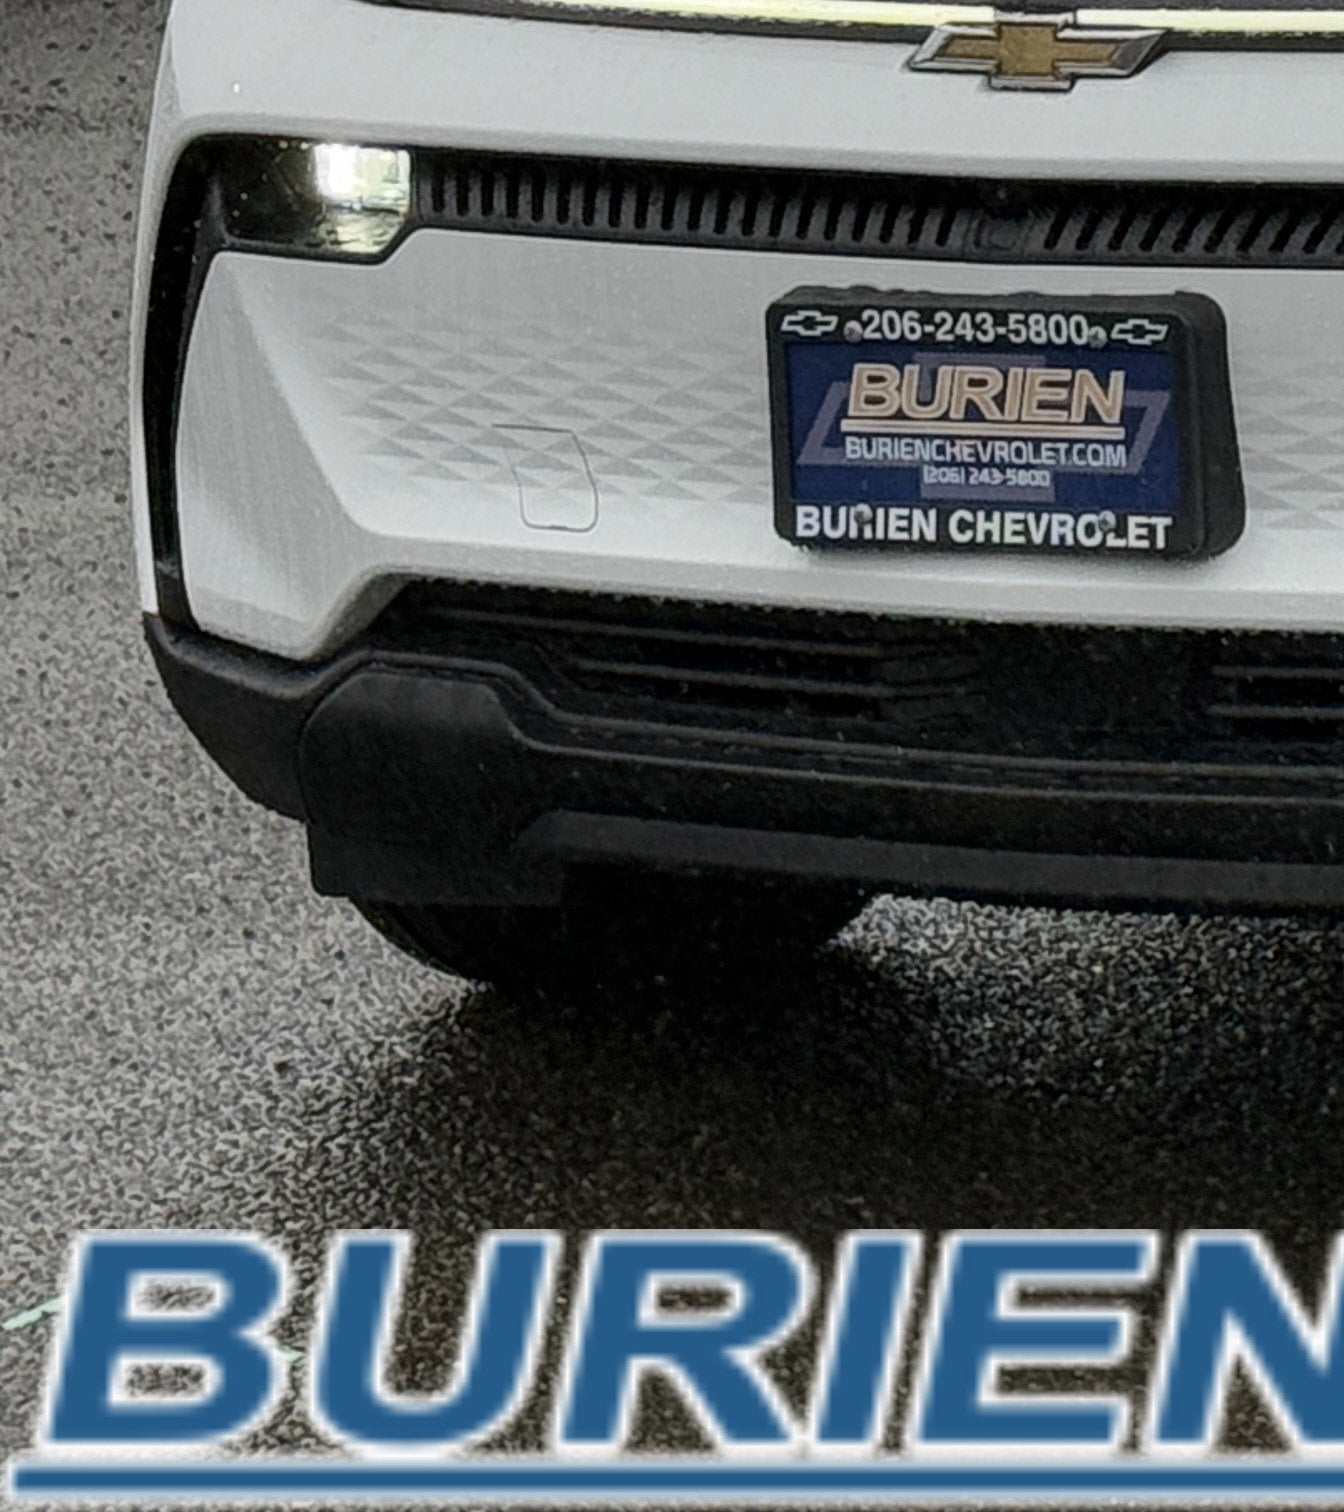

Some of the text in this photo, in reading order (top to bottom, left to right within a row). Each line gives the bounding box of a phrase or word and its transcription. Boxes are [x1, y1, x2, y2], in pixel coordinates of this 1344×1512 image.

[860, 309, 1089, 346] 206-243-5800
[846, 362, 1126, 425] BURIEN
[844, 436, 1127, 468] BURIENCHEVROLET.COM
[795, 505, 1173, 550] BURIEN CHEVROLET
